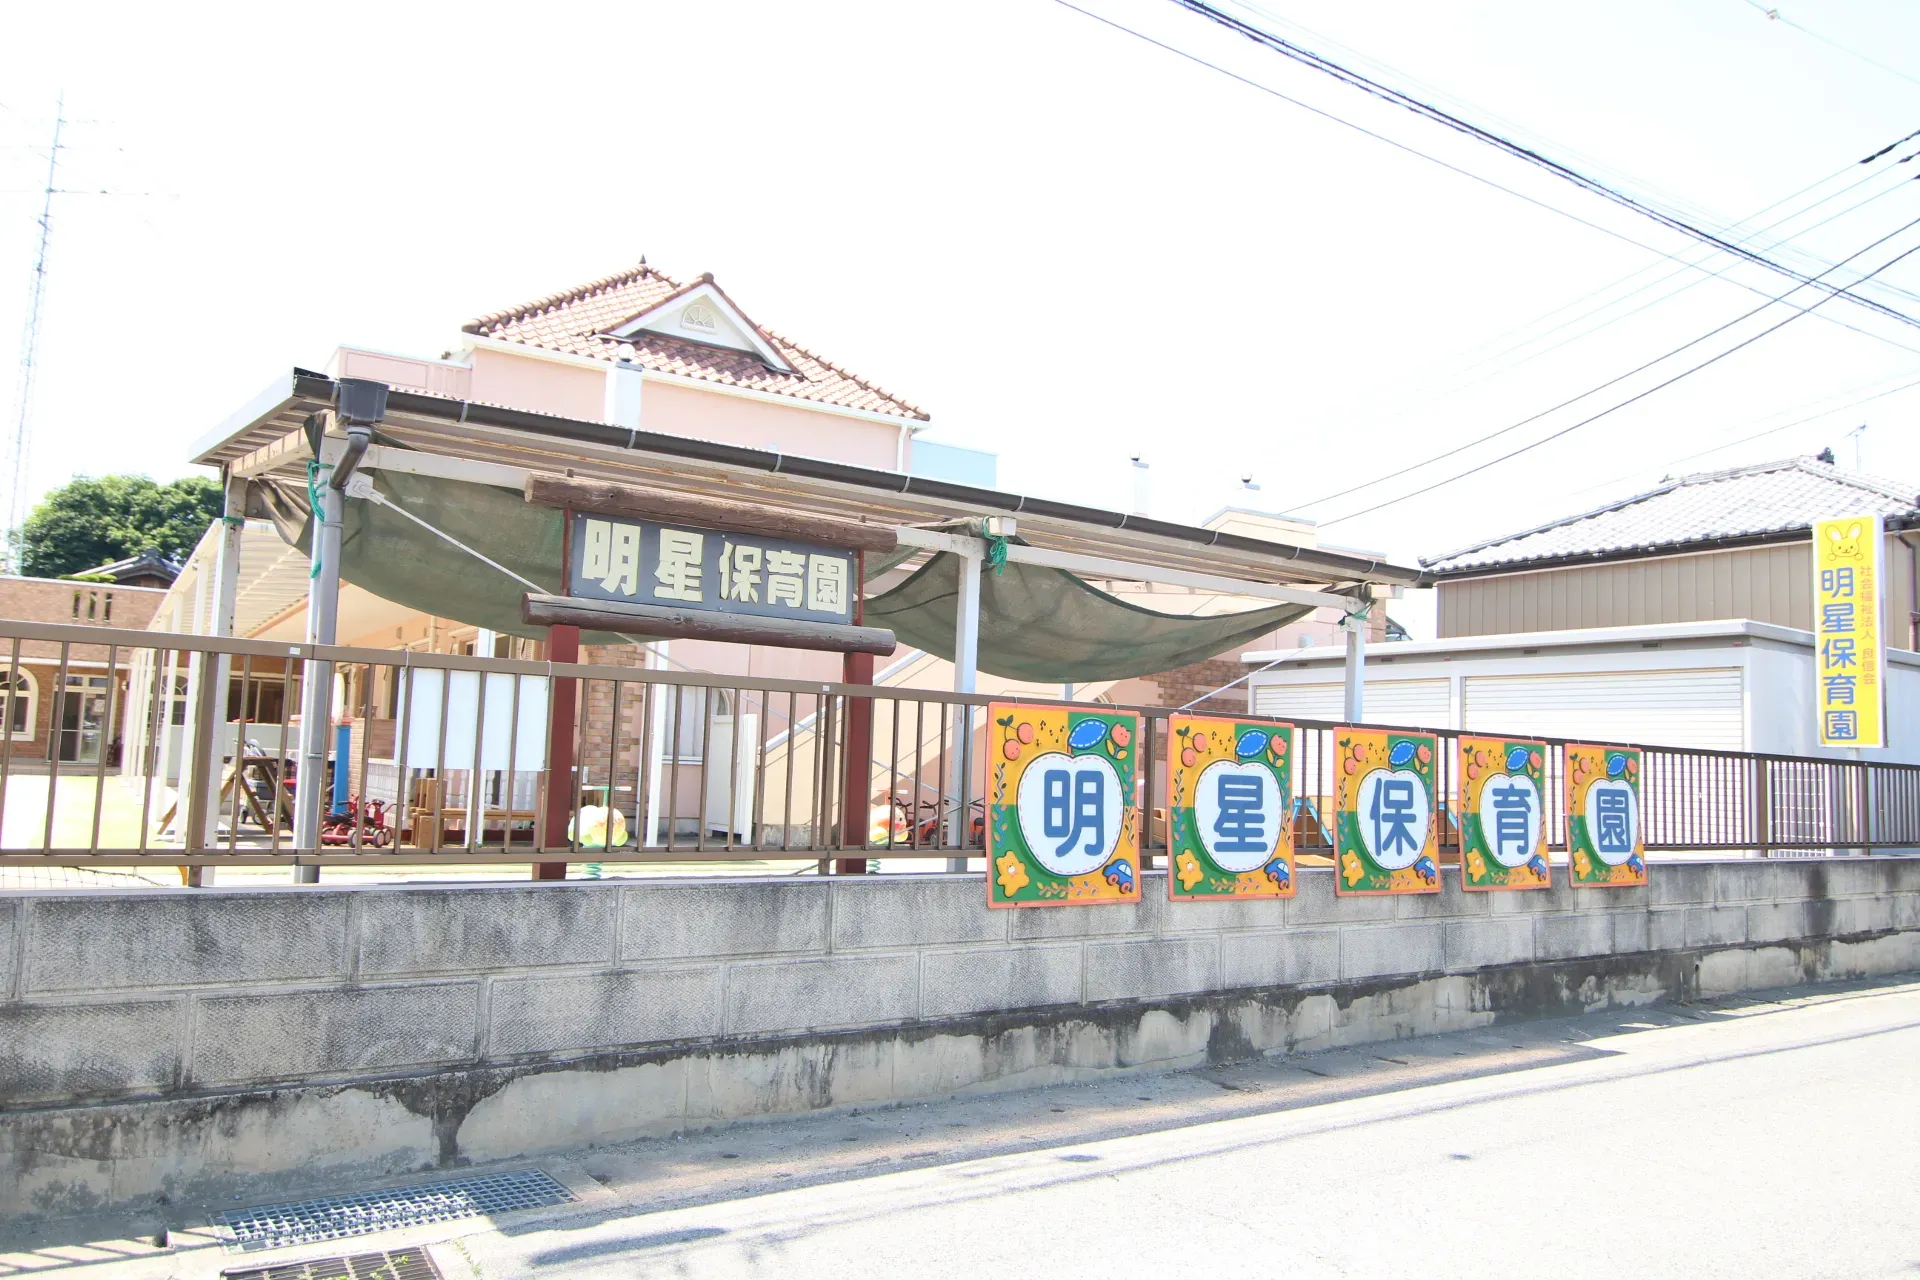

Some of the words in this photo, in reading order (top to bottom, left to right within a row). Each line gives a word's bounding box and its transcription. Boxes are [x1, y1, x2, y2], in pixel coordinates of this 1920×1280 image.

[582, 518, 849, 615] 明星保育園
[1859, 566, 1874, 639] 社会福祉法人
[1820, 567, 1858, 740] 明星保育園
[1043, 769, 1104, 858] 明
[1213, 774, 1268, 853] 星
[1369, 777, 1418, 857] 保
[1492, 783, 1532, 856] 育
[1595, 788, 1631, 853] 園
